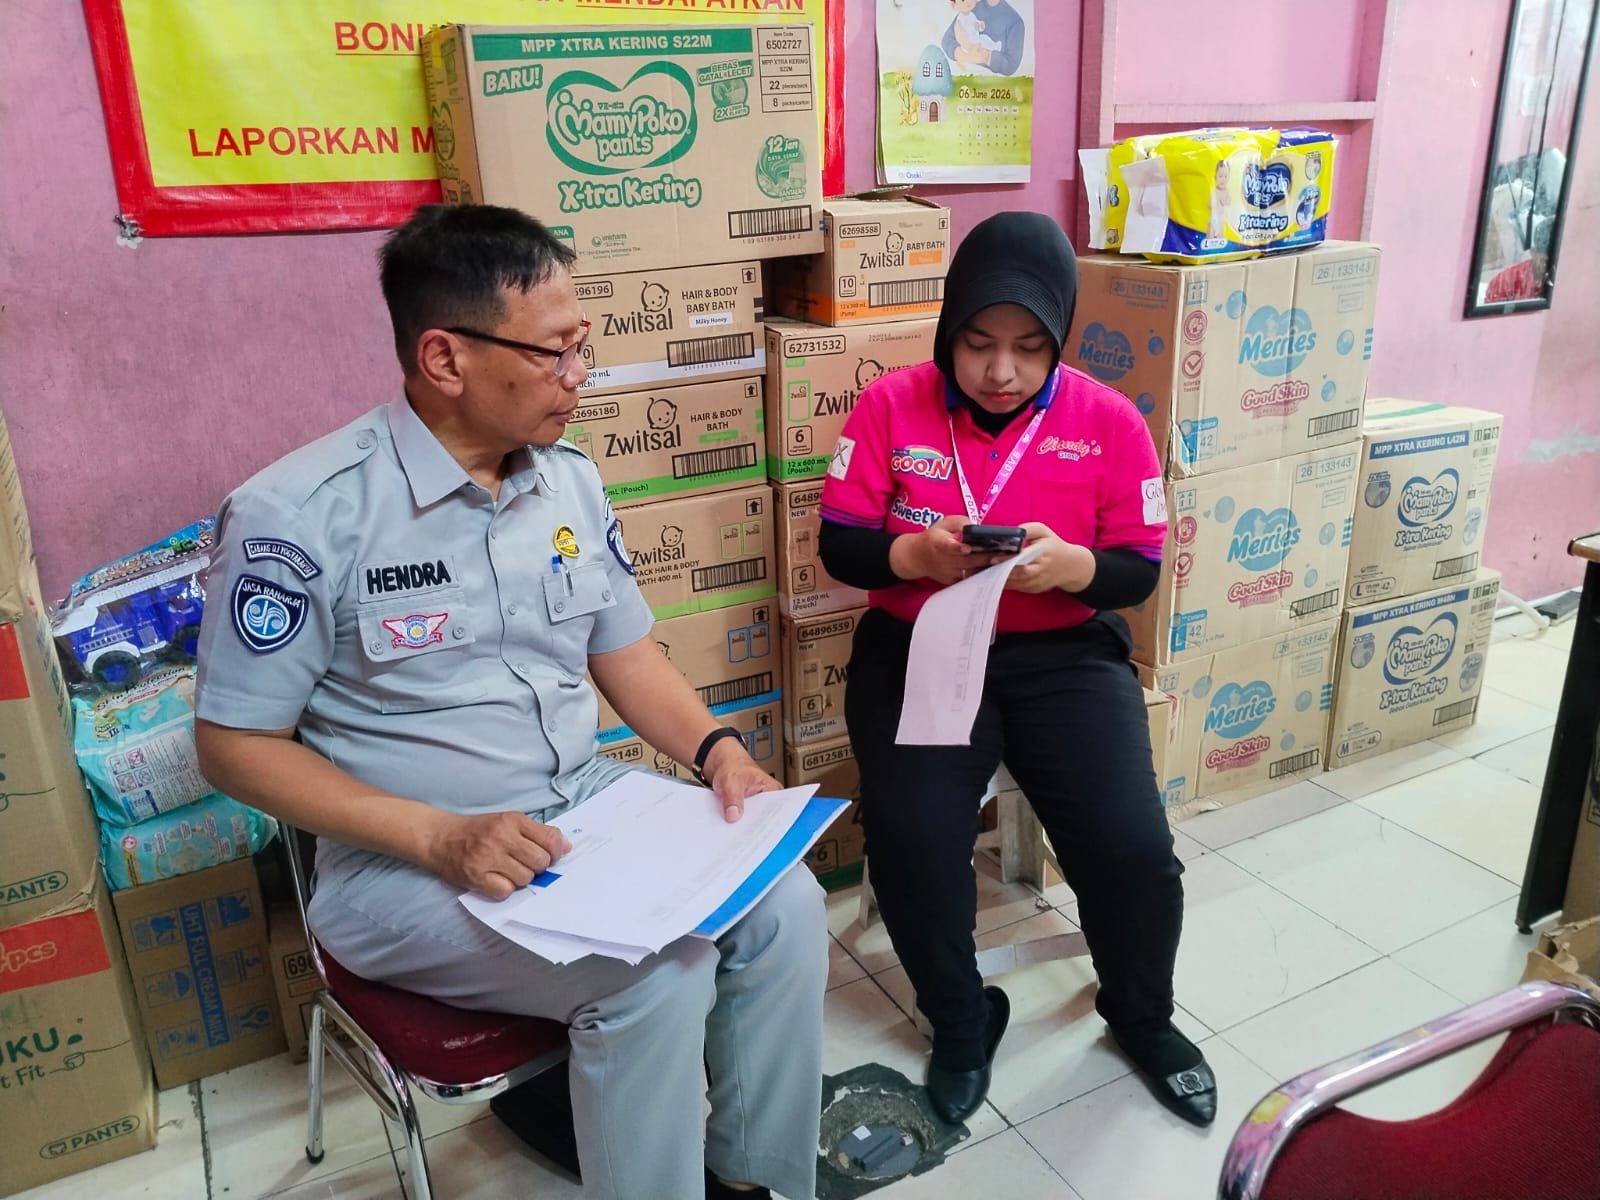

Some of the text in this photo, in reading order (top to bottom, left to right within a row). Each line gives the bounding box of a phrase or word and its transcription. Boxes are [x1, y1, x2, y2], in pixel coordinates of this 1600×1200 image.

[521, 34, 712, 53] MPP XTRA KERING S22M
[766, 39, 802, 50] 6502727
[711, 61, 738, 72] BEBAS
[485, 67, 541, 92] BARU!
[769, 81, 780, 90] 22
[959, 88, 1011, 99] 06 June 2026
[773, 97, 779, 107] 8
[557, 92, 685, 144] MamyPoko
[717, 109, 728, 119] 2X
[188, 126, 399, 157] LAPORKAN
[596, 132, 653, 161] pants
[767, 136, 784, 154] 12
[558, 173, 701, 212] X-tra Kering
[554, 229, 569, 237] ANA
[842, 225, 879, 236] 62698588
[906, 240, 945, 251] BABY BATH
[859, 250, 905, 269] Zwitsal
[1317, 263, 1370, 279] 26 133143
[842, 278, 854, 288] 10
[682, 286, 738, 300] HAIR & BODY
[686, 300, 736, 314] BABY BATH
[601, 308, 673, 337] Zwitsal
[711, 316, 728, 324] Honey
[583, 348, 591, 360] 0
[789, 340, 842, 354] 62731532
[1238, 329, 1317, 364] Merries
[1079, 341, 1136, 370] Merries
[587, 371, 597, 379] 00
[576, 380, 596, 389] uch)
[814, 389, 860, 417] Zwit
[690, 408, 743, 423] HAIR & BODY
[706, 422, 729, 432] BATH
[604, 424, 681, 458] Zwitsal
[795, 429, 804, 443] 6
[1200, 435, 1214, 447] 42
[1374, 437, 1446, 455] MPP XTRA KERING
[787, 465, 813, 475] (Pouch)
[788, 460, 798, 468] 12
[816, 457, 828, 465] mL
[1001, 450, 1021, 478] LOVE
[1301, 460, 1352, 477] 26 133143
[608, 484, 649, 496] mL (Pouch)
[794, 492, 824, 504] 6489
[892, 500, 942, 528] Sweety
[1421, 524, 1453, 543] Kering
[1227, 527, 1301, 563] Merries
[630, 543, 685, 568] Zwitsal
[655, 565, 673, 576] HAIR
[679, 559, 700, 570] BODY
[366, 559, 451, 595] HENDRA
[637, 573, 682, 587] BATH 400 mL
[799, 569, 808, 582] 6
[242, 582, 302, 609] JASA RAHARJA
[1189, 625, 1202, 637] 42
[1175, 632, 1183, 647] L
[807, 698, 816, 711] 6
[1204, 696, 1277, 735] Merries
[606, 747, 629, 761] 2148
[816, 847, 827, 862] 6
[1, 1027, 60, 1066] KU
[16, 1065, 45, 1086] Fit
[72, 1119, 133, 1148] PANTS
